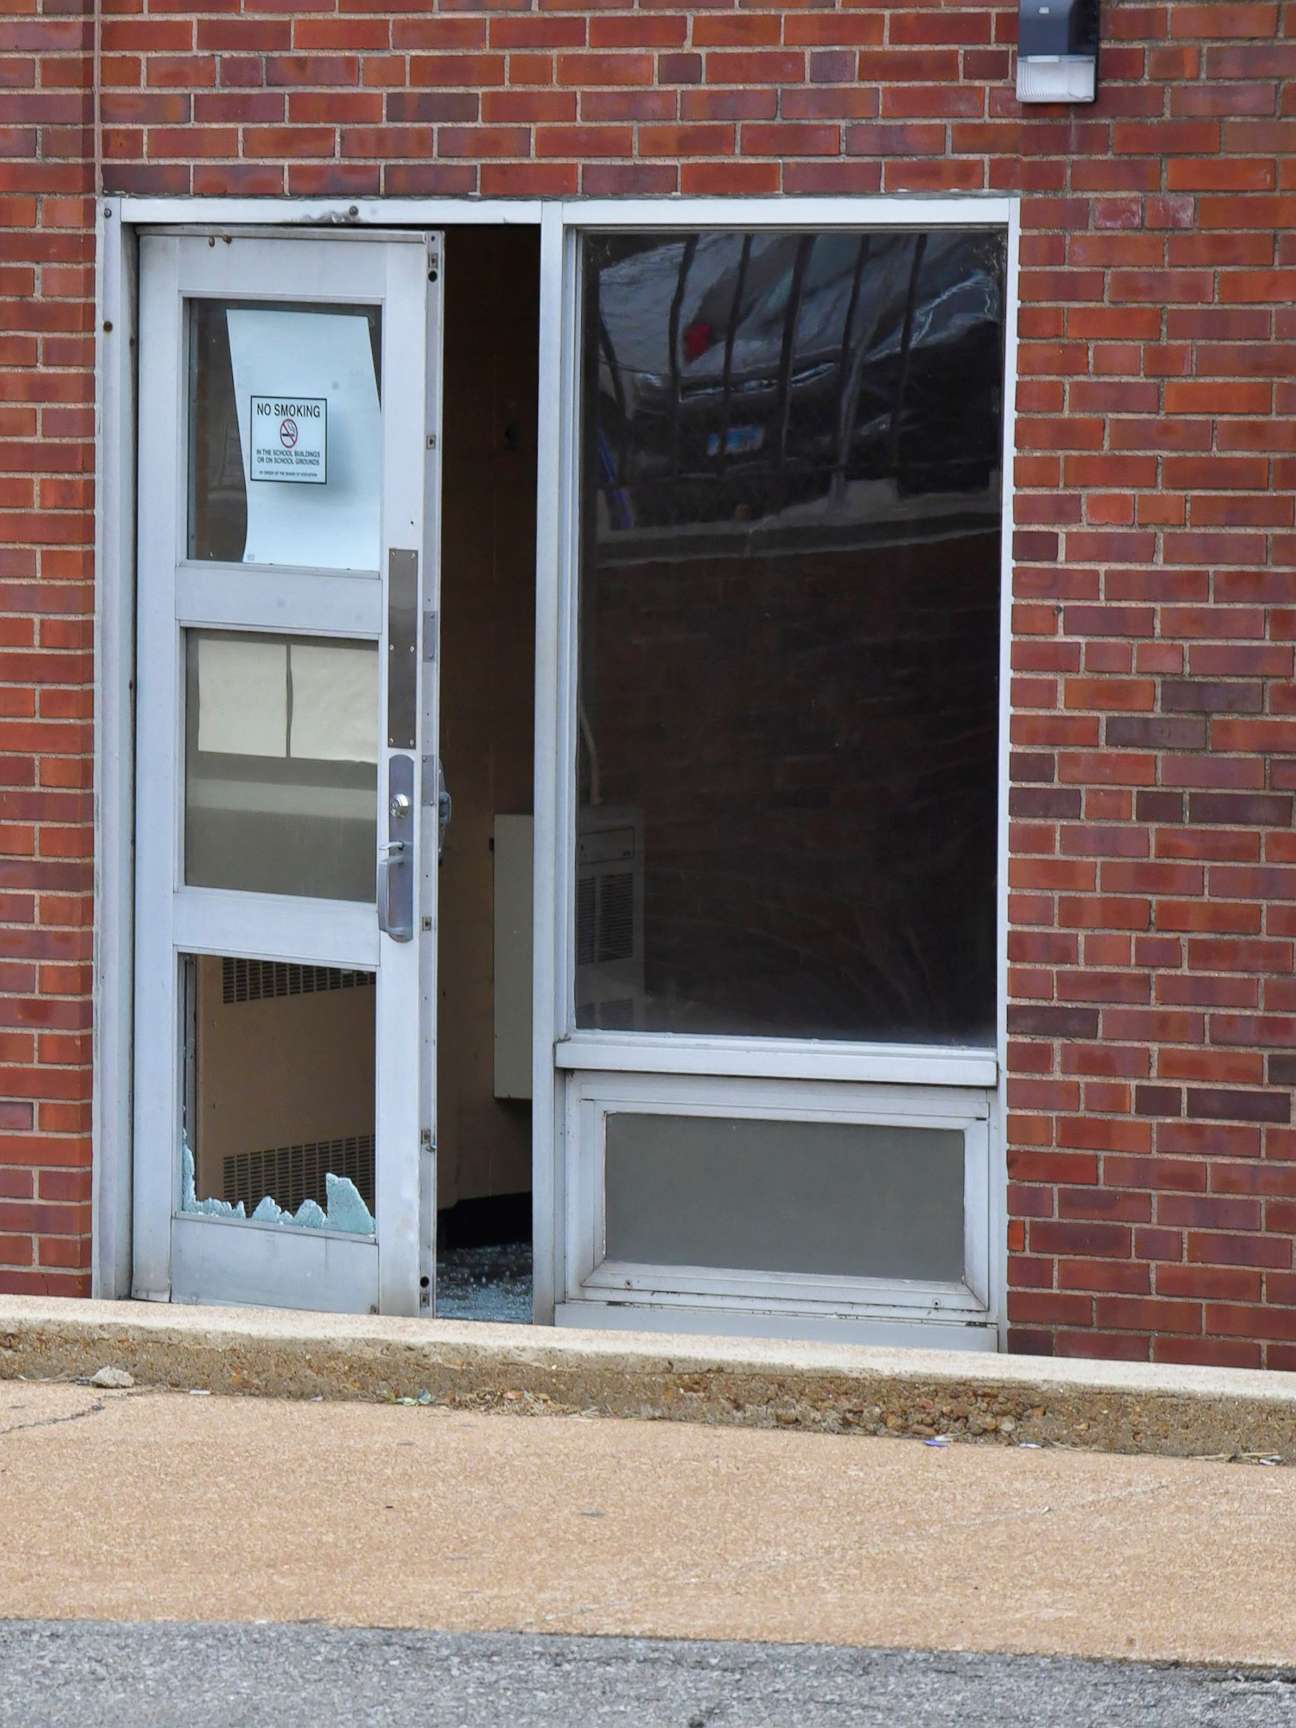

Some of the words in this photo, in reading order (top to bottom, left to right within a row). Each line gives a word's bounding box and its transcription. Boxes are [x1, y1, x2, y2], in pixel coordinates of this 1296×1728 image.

[256, 403, 271, 416] NO
[274, 404, 320, 418] SMOKING
[272, 449, 293, 458] SCHOOL
[294, 450, 320, 458] BUILDINGS
[256, 456, 265, 464] OR
[273, 457, 294, 465] SCHOOL
[295, 458, 320, 466] GROUNDS
